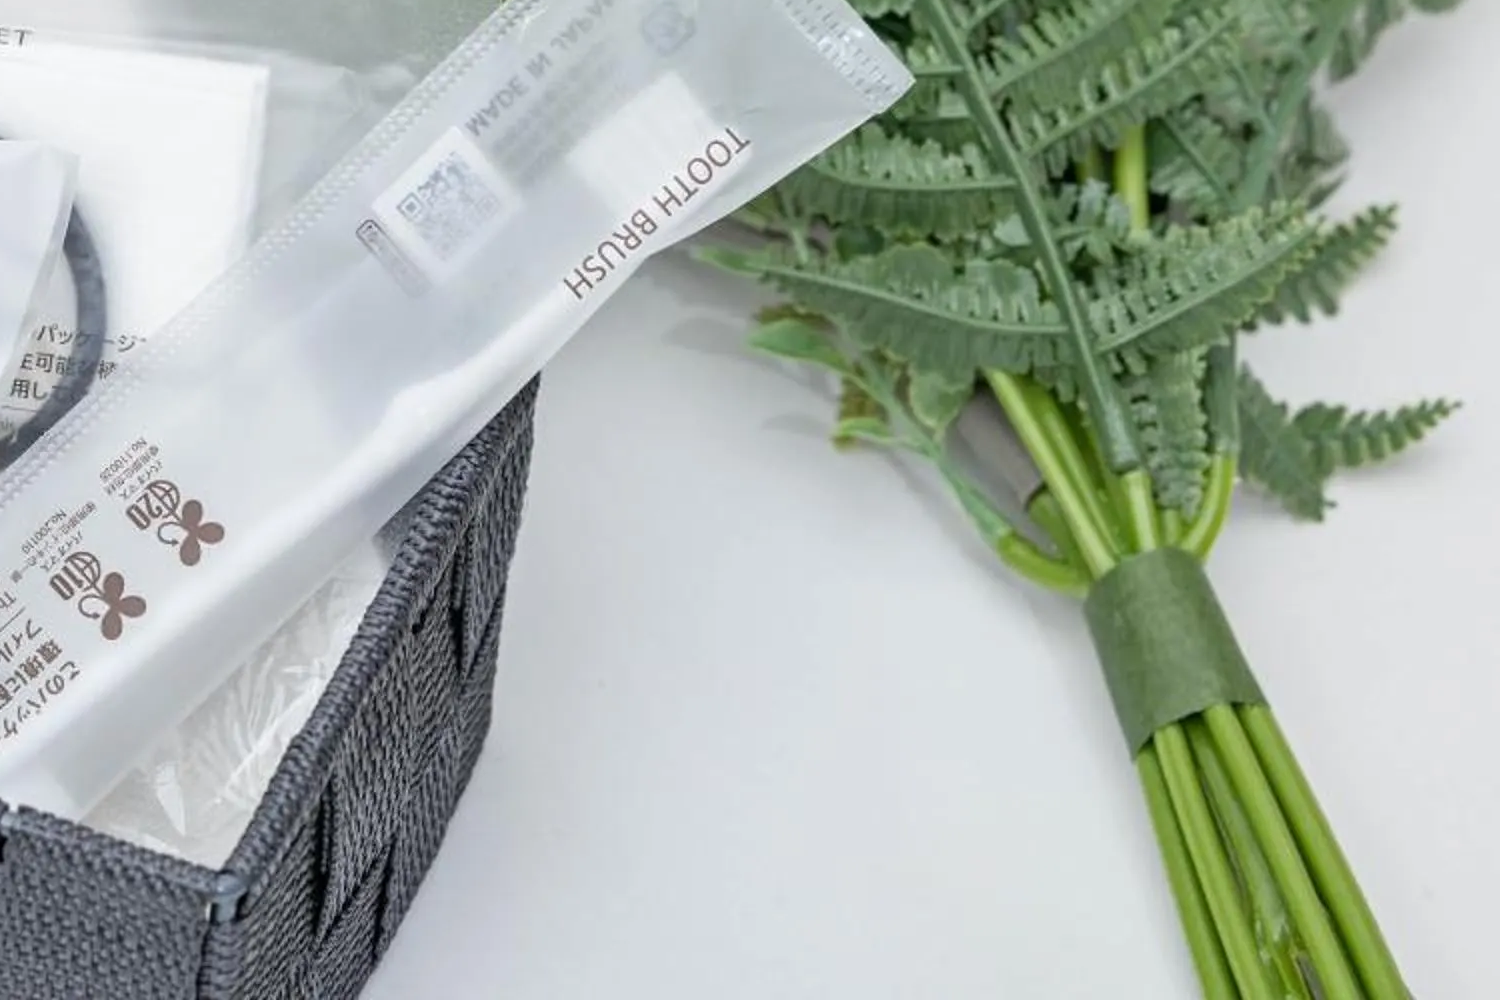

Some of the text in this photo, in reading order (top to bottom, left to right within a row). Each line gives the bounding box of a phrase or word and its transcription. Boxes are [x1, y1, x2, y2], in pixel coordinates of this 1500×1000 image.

[563, 128, 751, 300] TOOTH BRUSH
[36, 323, 146, 352] パッケージ
[126, 493, 162, 530] 20
[50, 565, 84, 601] 10
